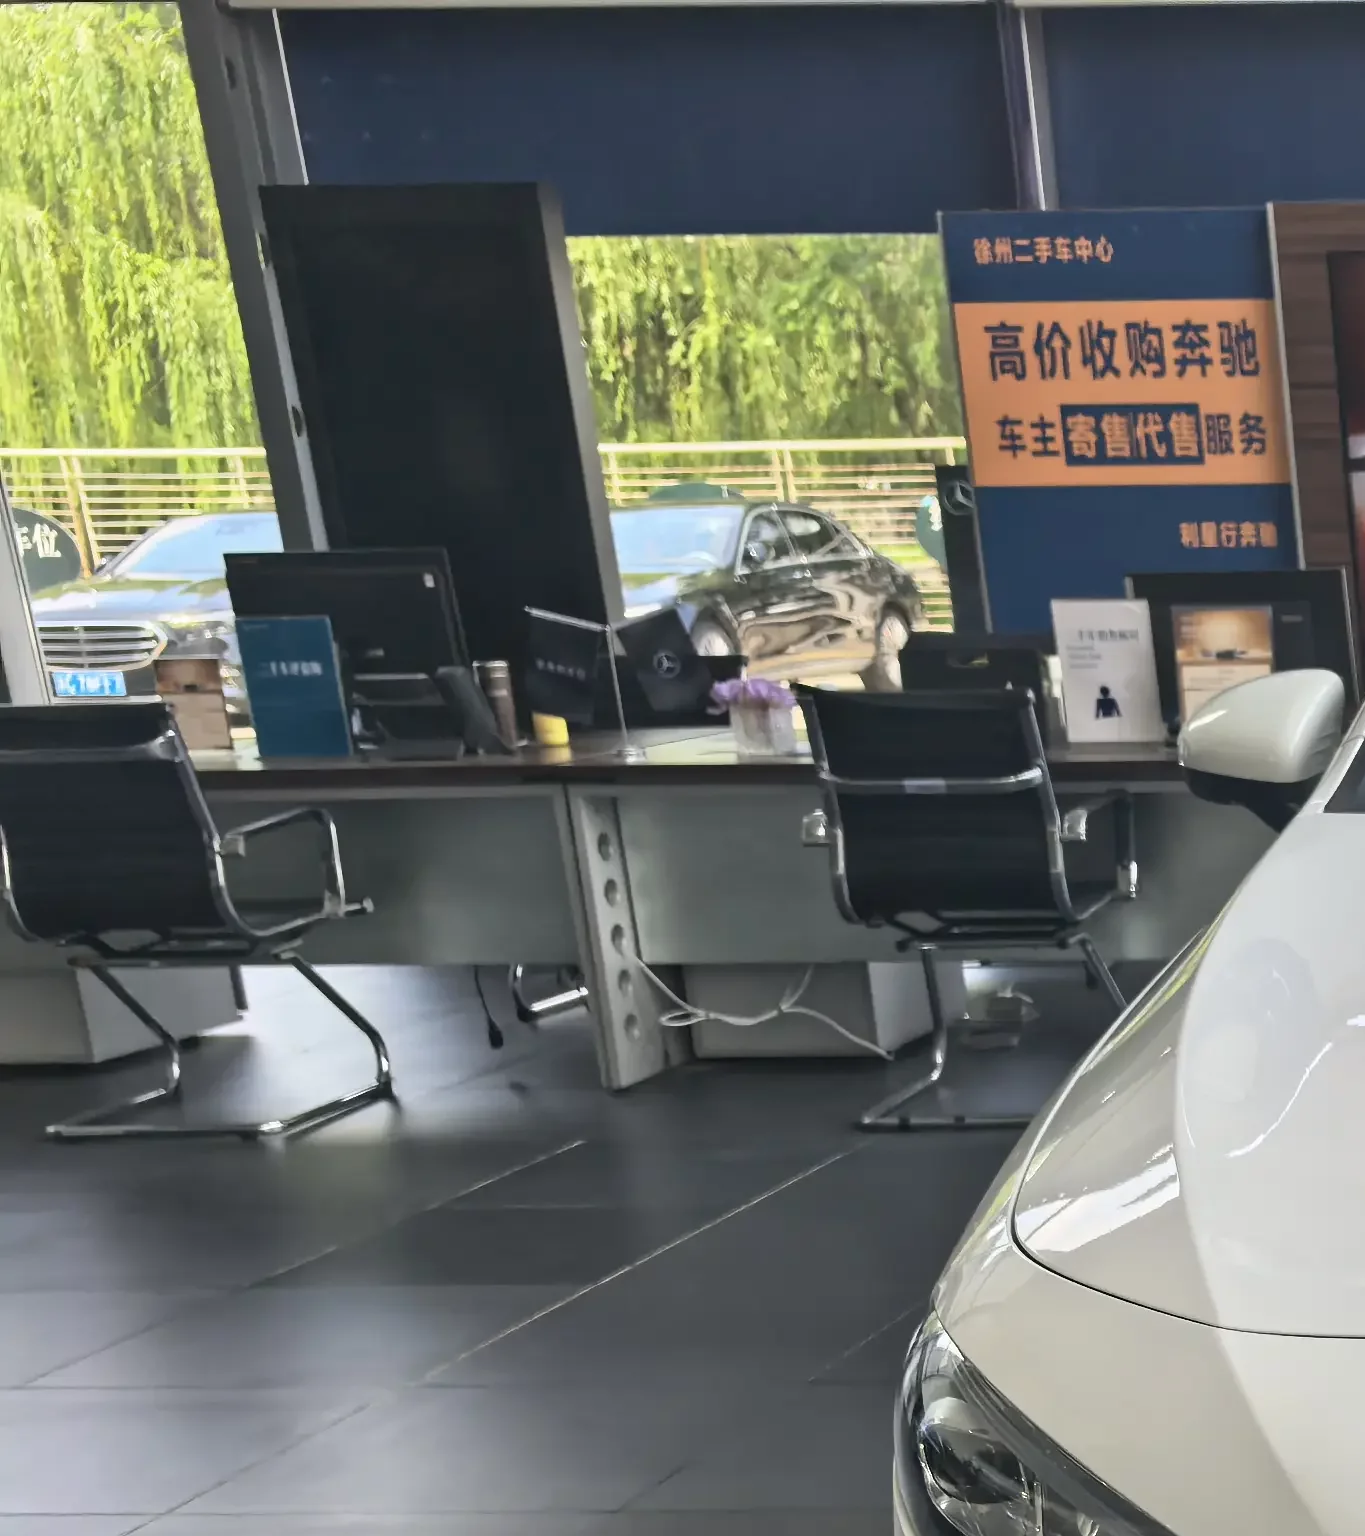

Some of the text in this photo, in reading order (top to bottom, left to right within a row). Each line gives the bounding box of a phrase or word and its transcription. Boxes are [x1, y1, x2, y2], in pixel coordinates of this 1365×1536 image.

[974, 235, 1114, 265] 徐州二手车中心
[983, 318, 1261, 381] 高价收购奔驰
